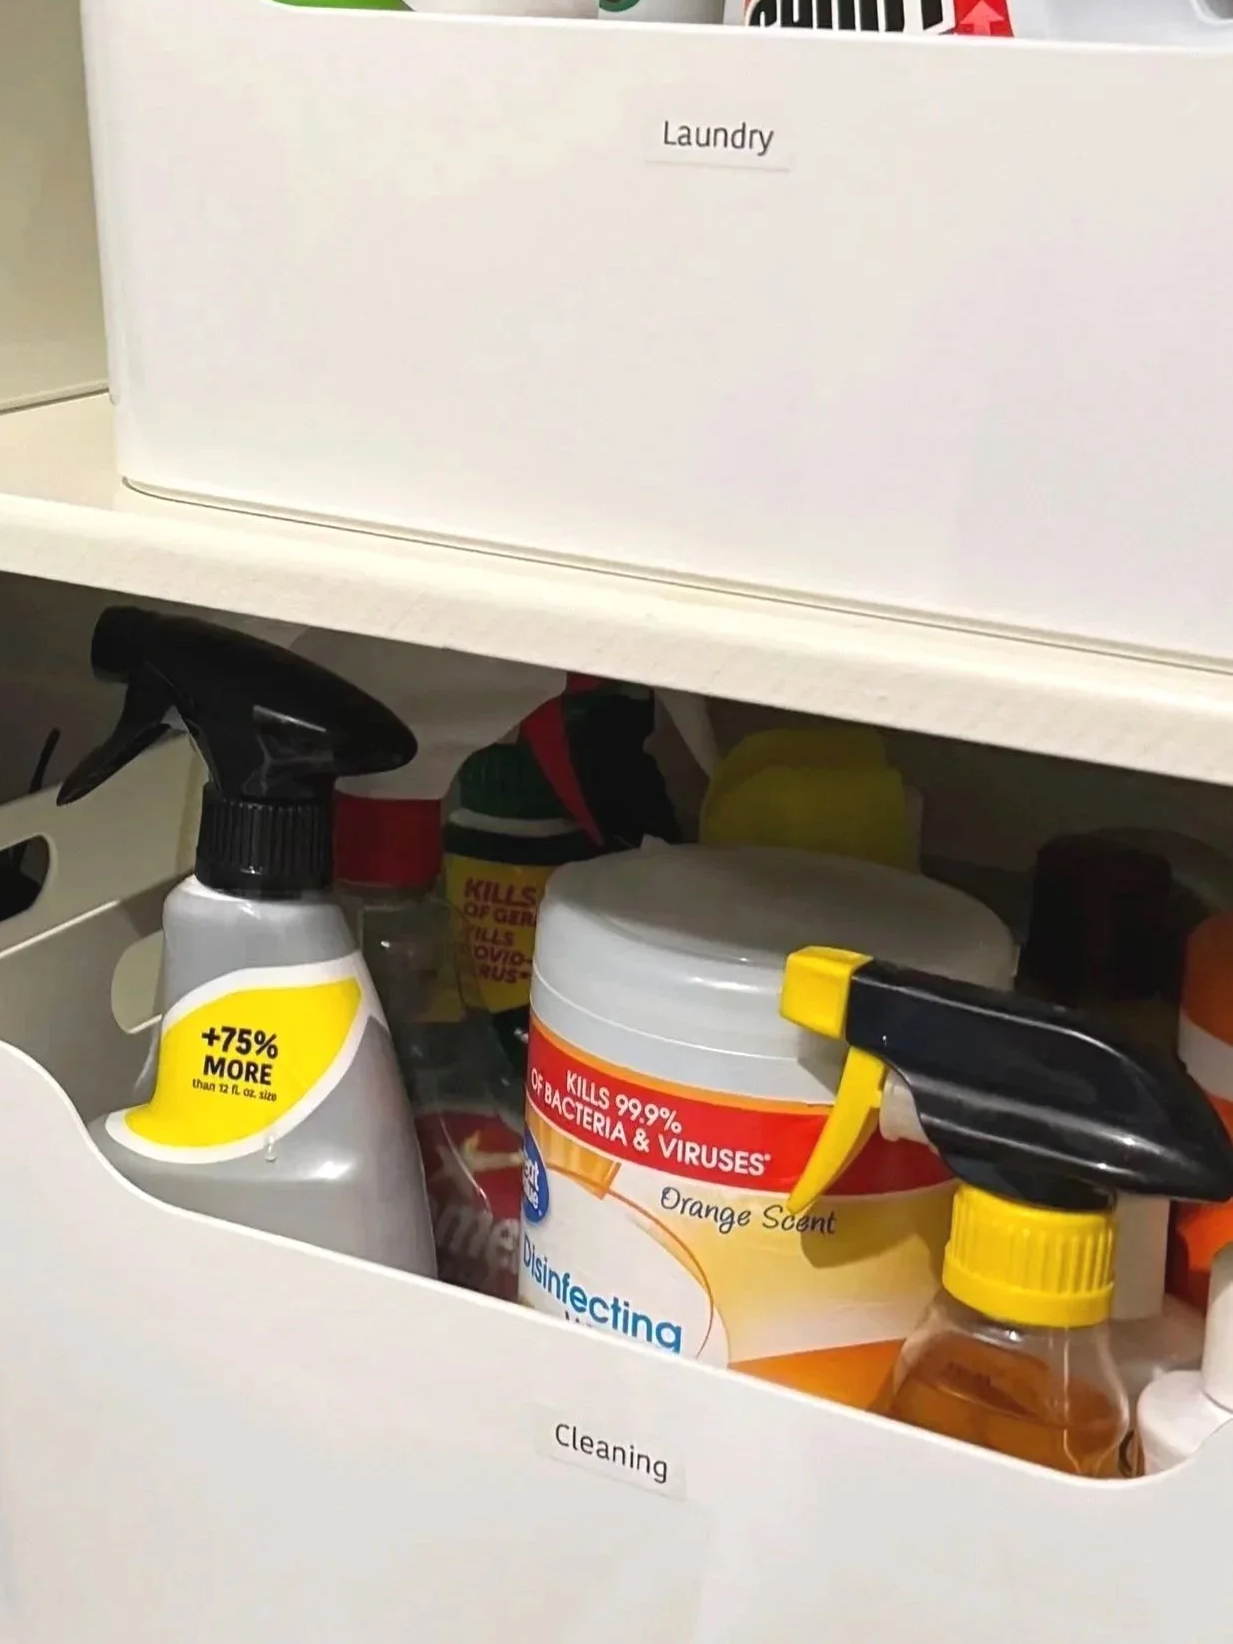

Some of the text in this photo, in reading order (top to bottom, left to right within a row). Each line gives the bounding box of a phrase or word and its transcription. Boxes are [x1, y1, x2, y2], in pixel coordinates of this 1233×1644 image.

[663, 120, 775, 157] Laundry
[464, 877, 537, 907] KILLS
[493, 907, 537, 928] GER
[201, 1025, 279, 1060] +75%
[203, 1055, 273, 1086] MORE
[192, 1078, 216, 1092] than
[219, 1083, 229, 1094] 12
[258, 1090, 278, 1102] size
[566, 1069, 683, 1135] KILLS 99.9%
[531, 1067, 544, 1093] OF
[544, 1081, 628, 1147] BACTERIA
[632, 1128, 651, 1154] &
[660, 1186, 839, 1236] Orange Scent
[555, 1423, 669, 1485] Cleaning
